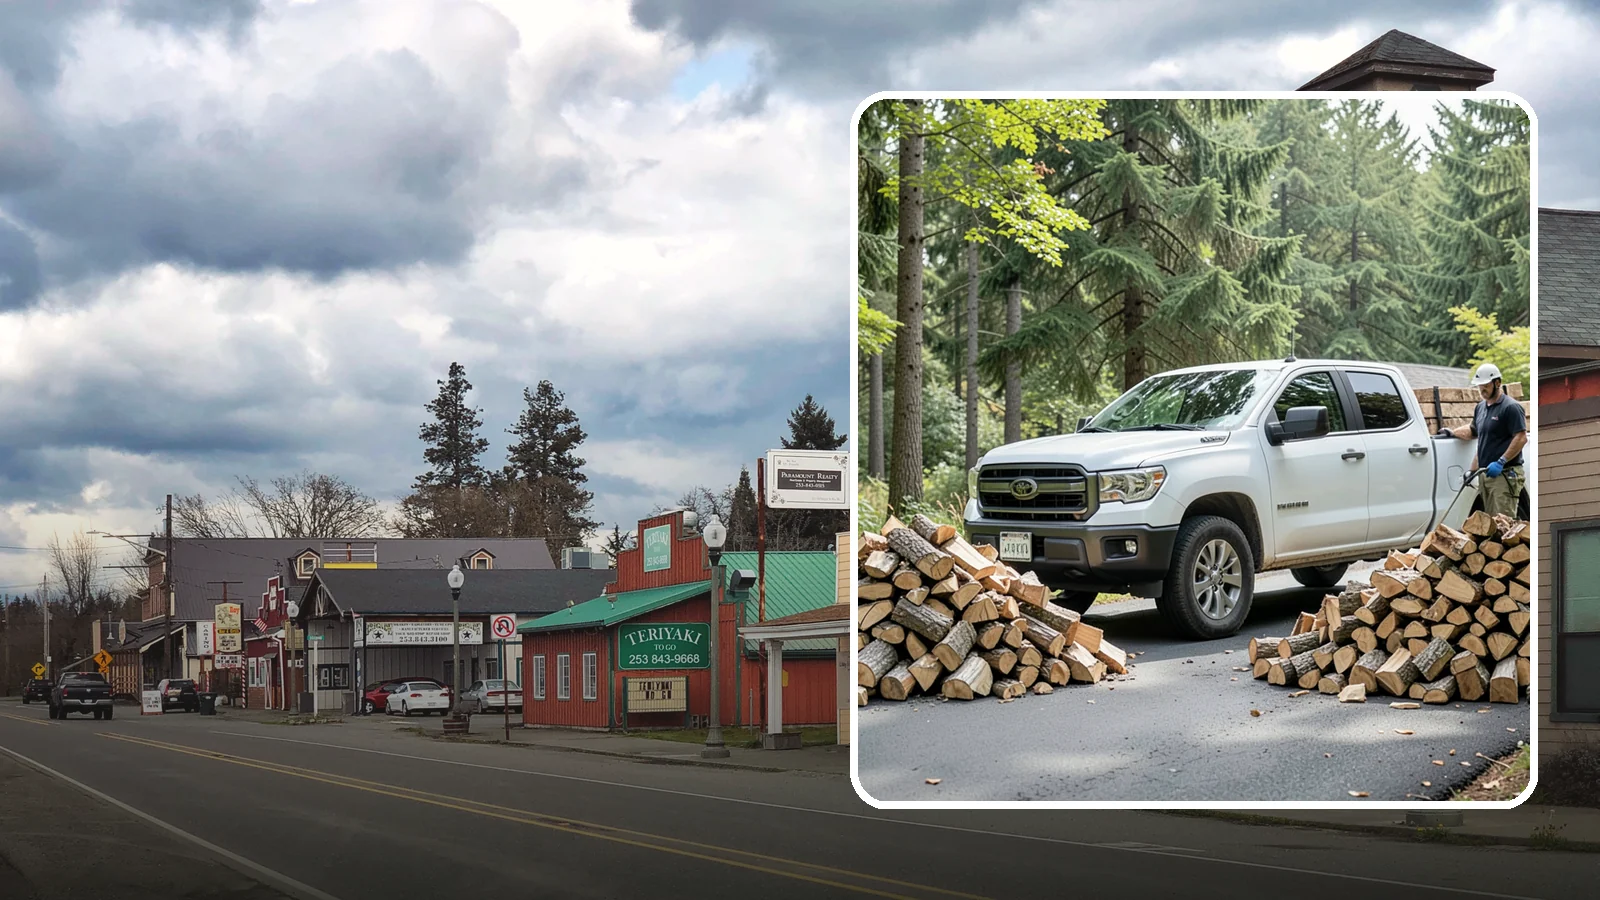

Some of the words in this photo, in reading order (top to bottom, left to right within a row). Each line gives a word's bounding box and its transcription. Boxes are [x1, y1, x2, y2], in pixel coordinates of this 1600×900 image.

[624, 627, 702, 646] TERIYAKI
[629, 654, 648, 664] 253
[652, 654, 700, 664] 843-9668
[639, 681, 672, 690] TERIYAKI
